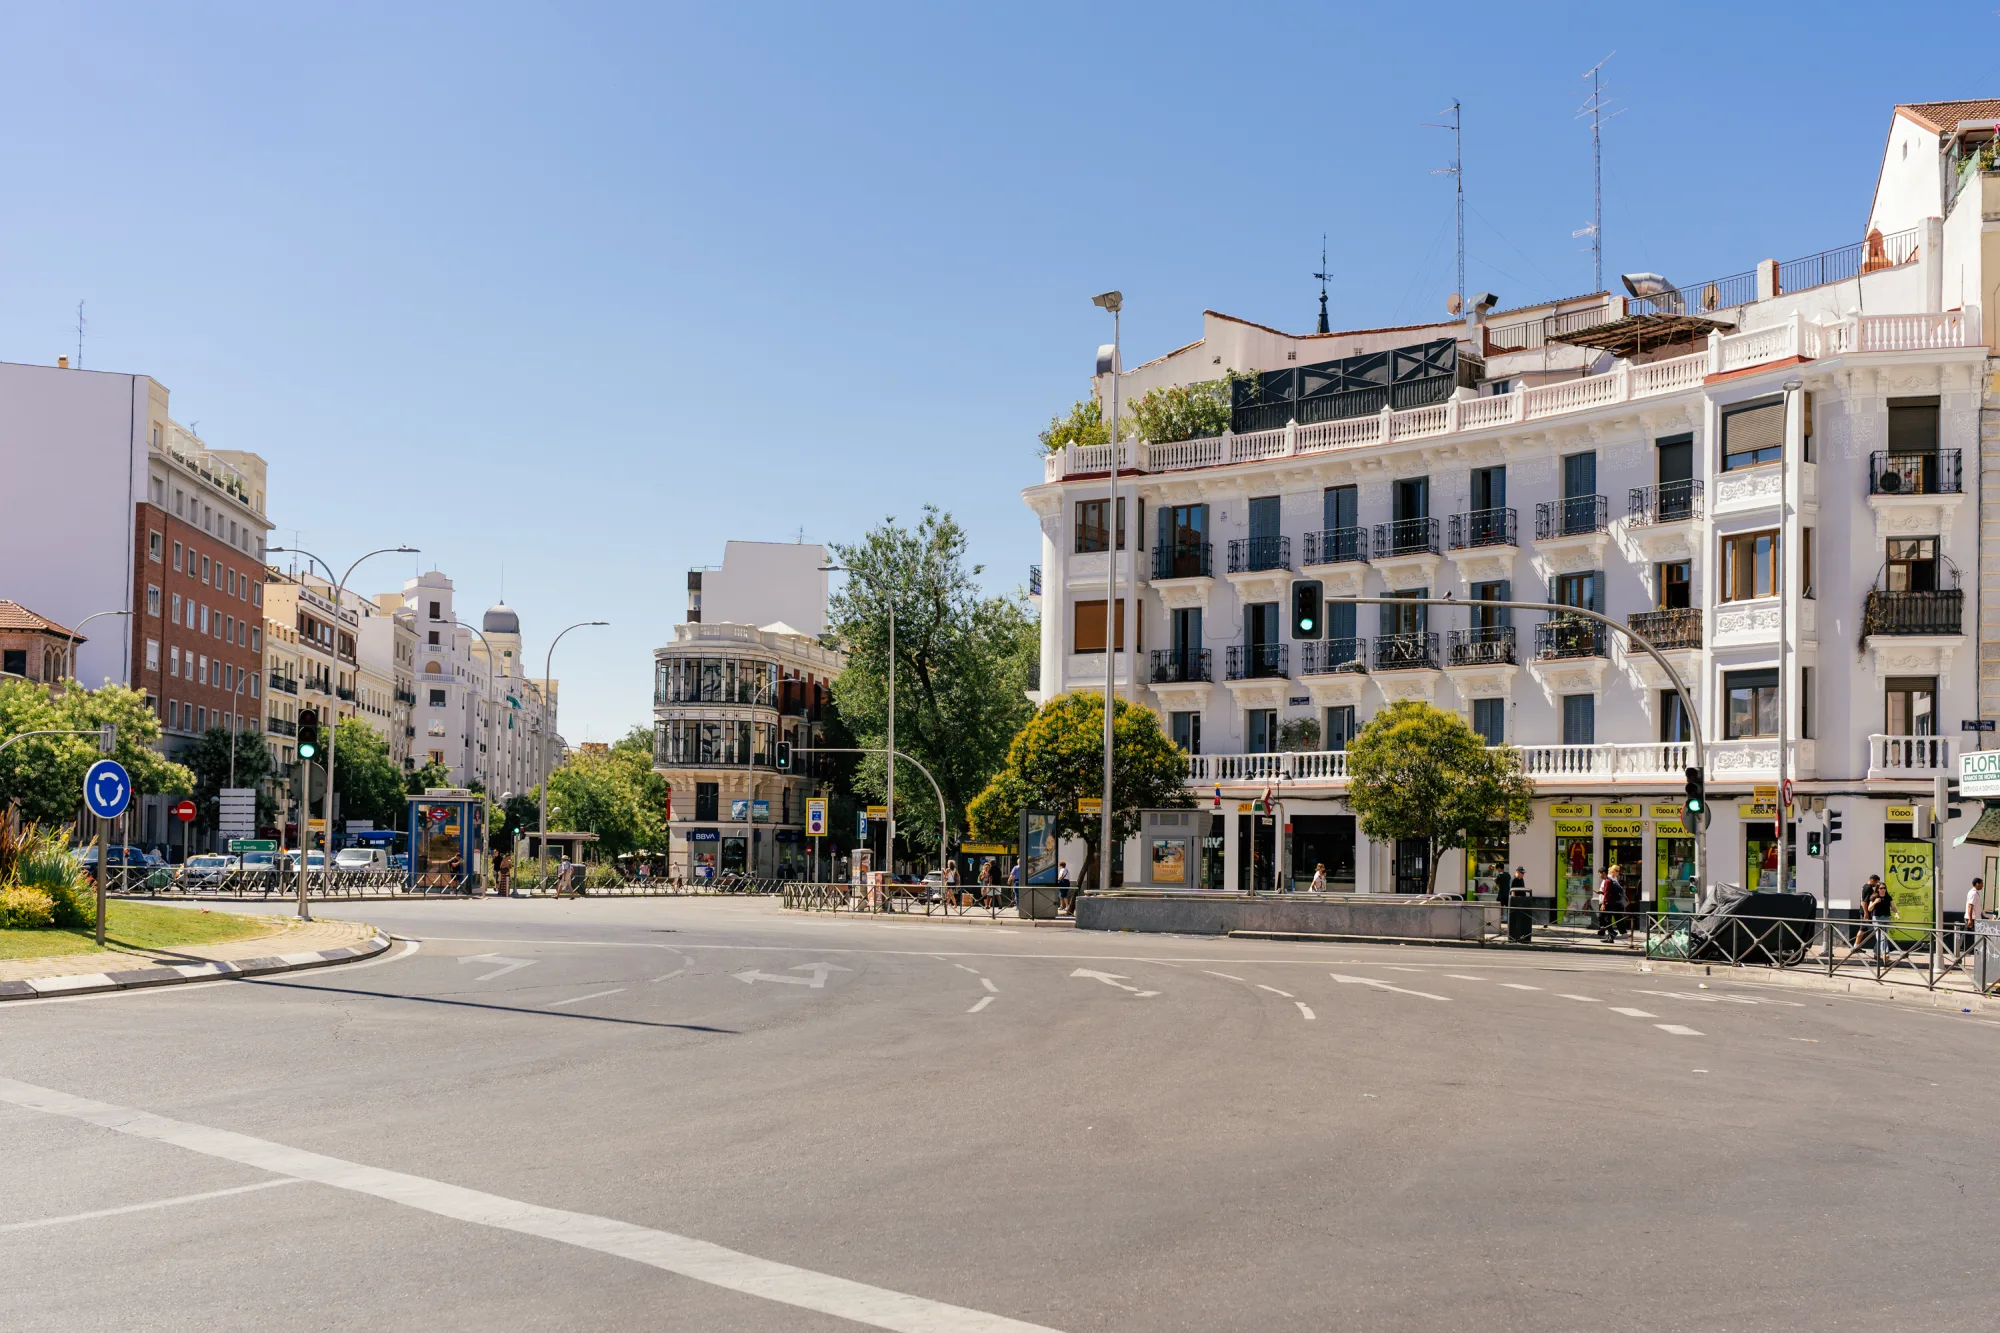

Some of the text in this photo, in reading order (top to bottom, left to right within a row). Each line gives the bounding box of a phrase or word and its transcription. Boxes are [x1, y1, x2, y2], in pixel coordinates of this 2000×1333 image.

[1558, 825, 1575, 833] TODO
[1584, 824, 1593, 833] 10
[1631, 825, 1640, 833] 10
[1889, 855, 1926, 863] TODO
[1889, 865, 1924, 881] A 10
